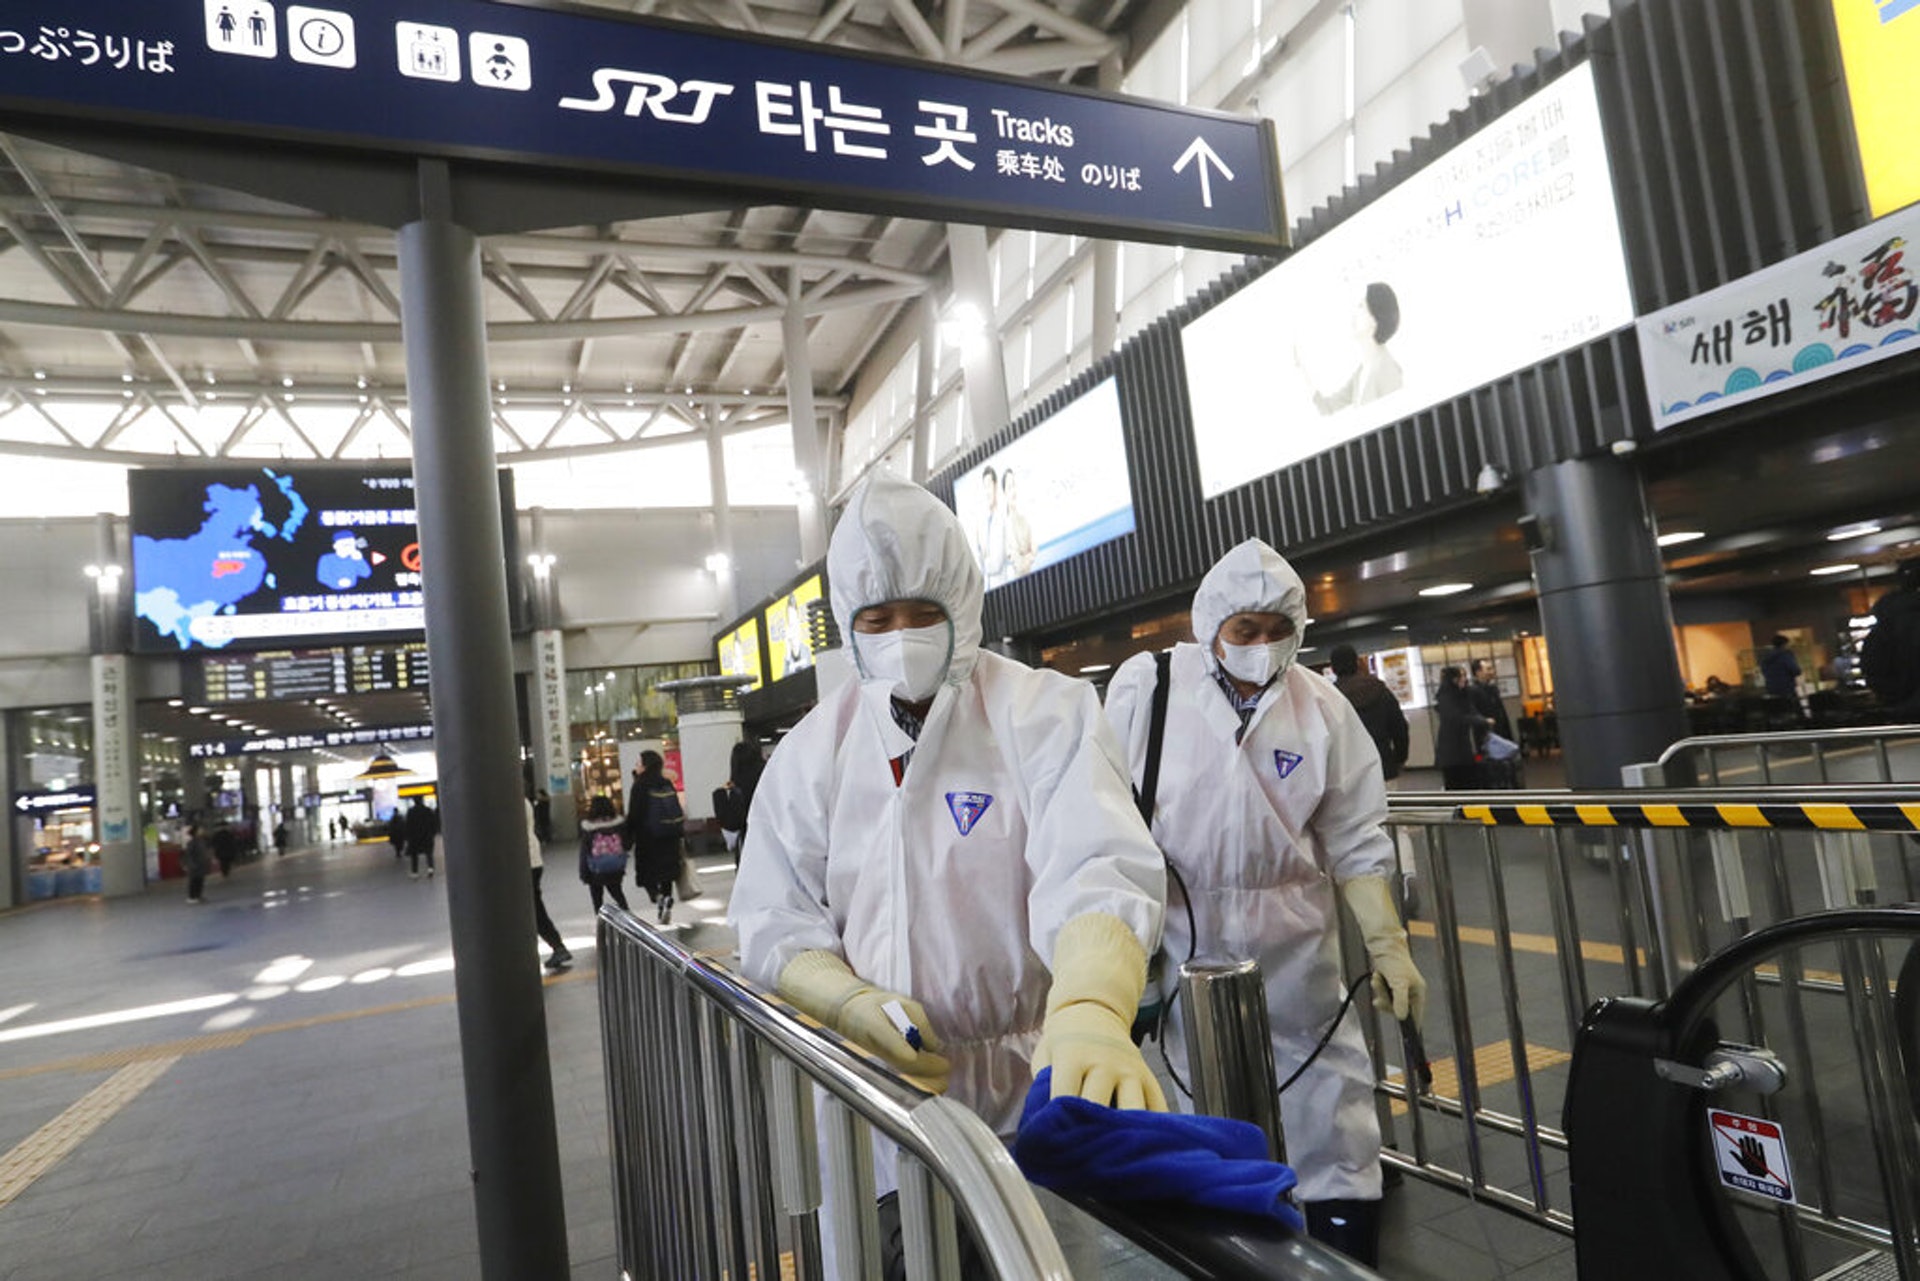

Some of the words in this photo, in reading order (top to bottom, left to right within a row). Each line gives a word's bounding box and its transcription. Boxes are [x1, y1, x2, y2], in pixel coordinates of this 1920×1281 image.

[558, 67, 735, 124] SRT
[755, 80, 891, 160] 타는
[914, 101, 977, 173] 곳
[991, 108, 1074, 148] Tracks
[1081, 163, 1142, 191] のりば
[1690, 297, 1793, 366] 새해
